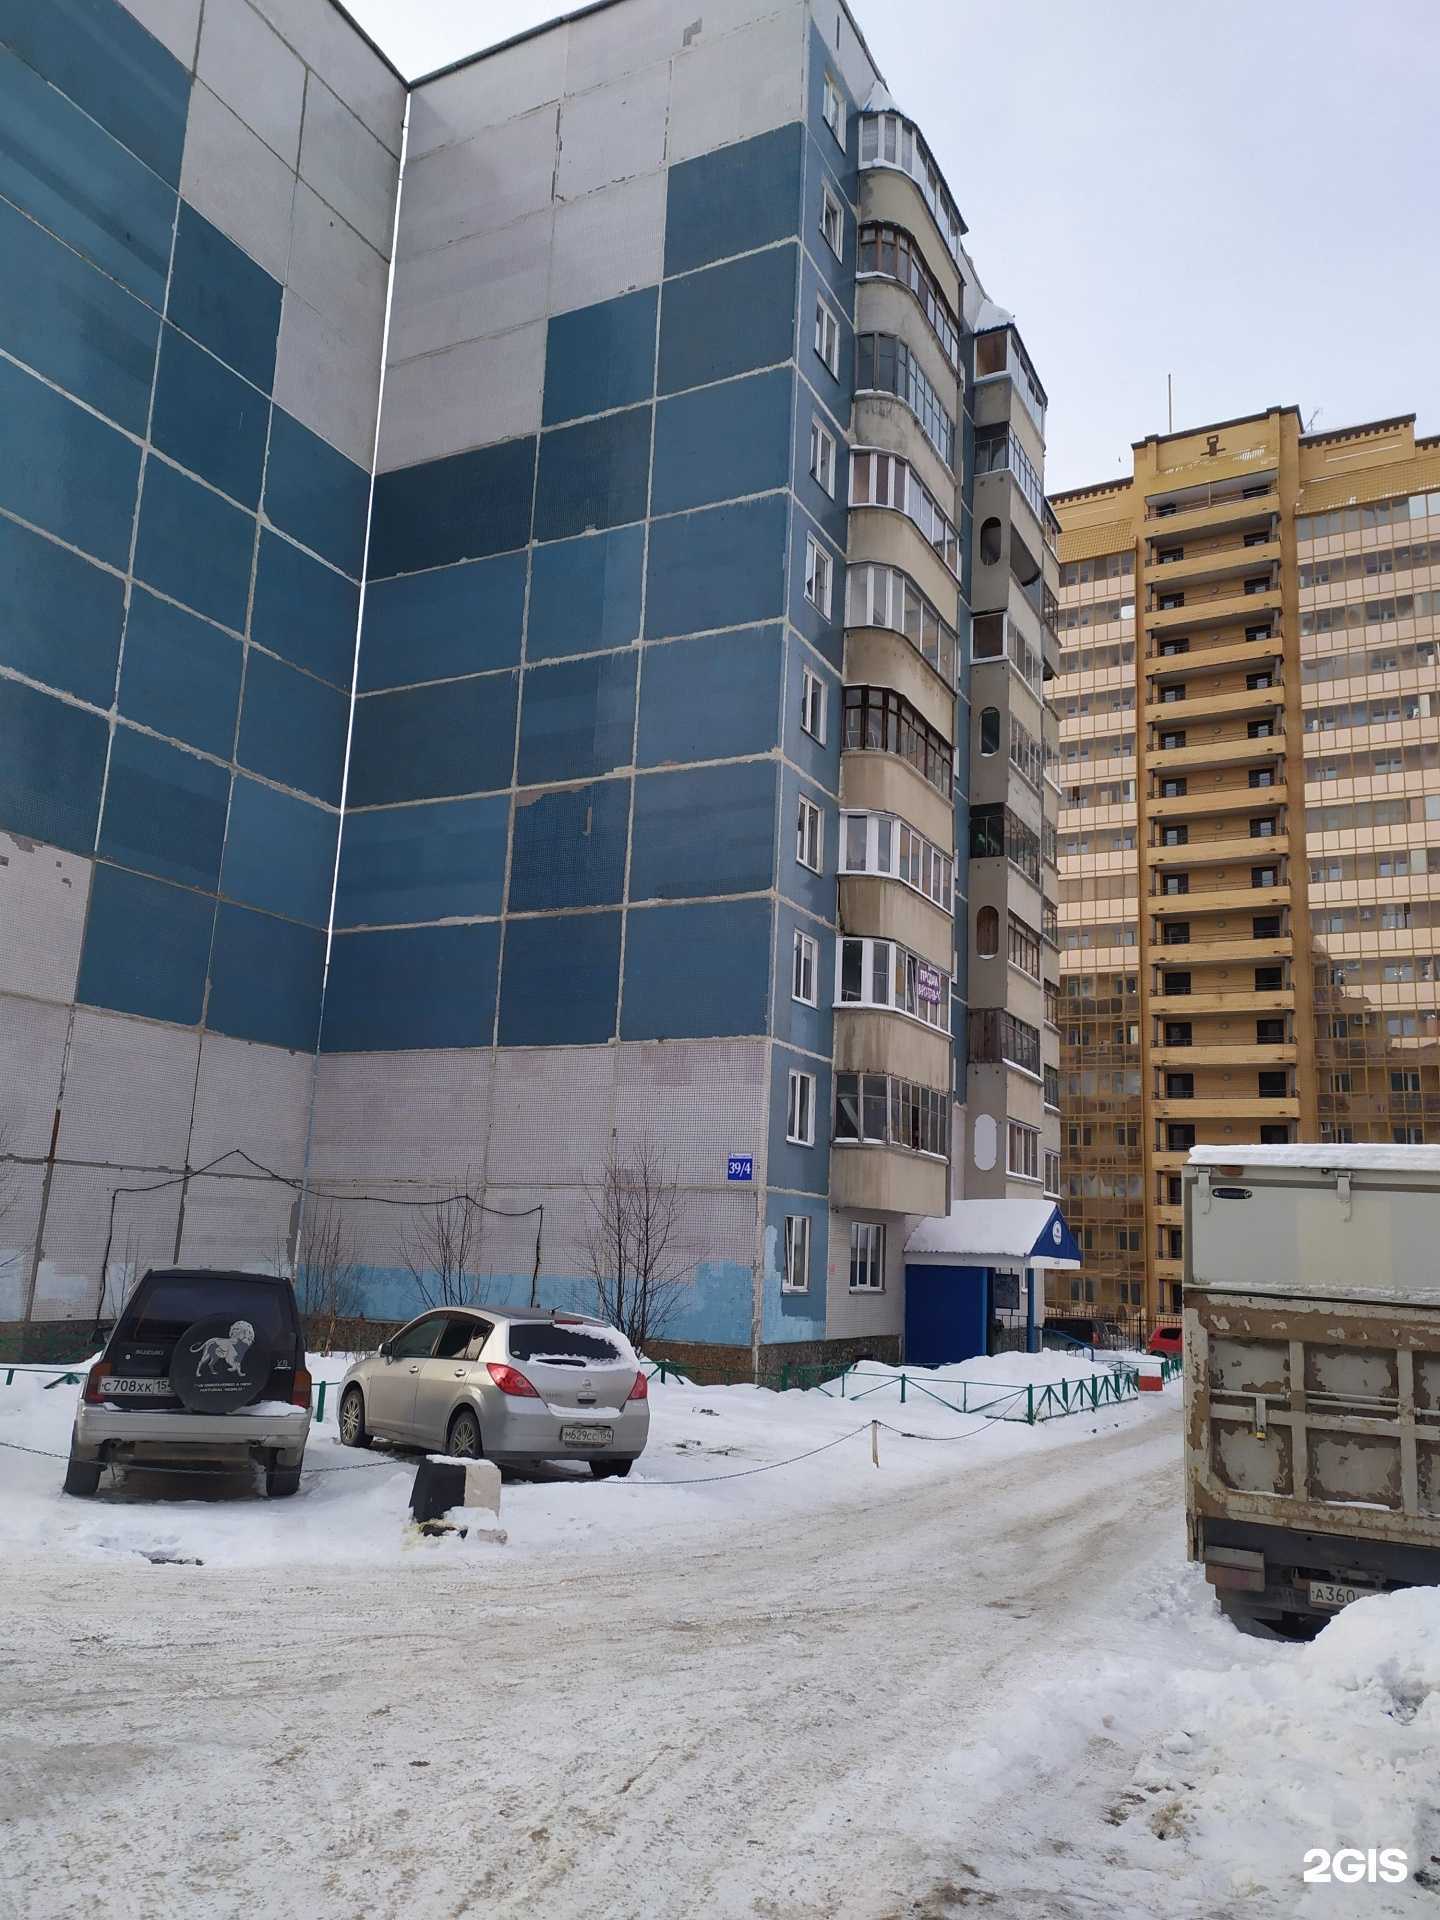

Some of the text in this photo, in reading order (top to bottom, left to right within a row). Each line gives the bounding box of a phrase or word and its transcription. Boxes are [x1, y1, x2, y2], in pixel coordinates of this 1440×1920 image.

[729, 1162, 751, 1177] 39/4
[103, 1379, 152, 1392] С708ХК
[1315, 1585, 1361, 1603] А360
